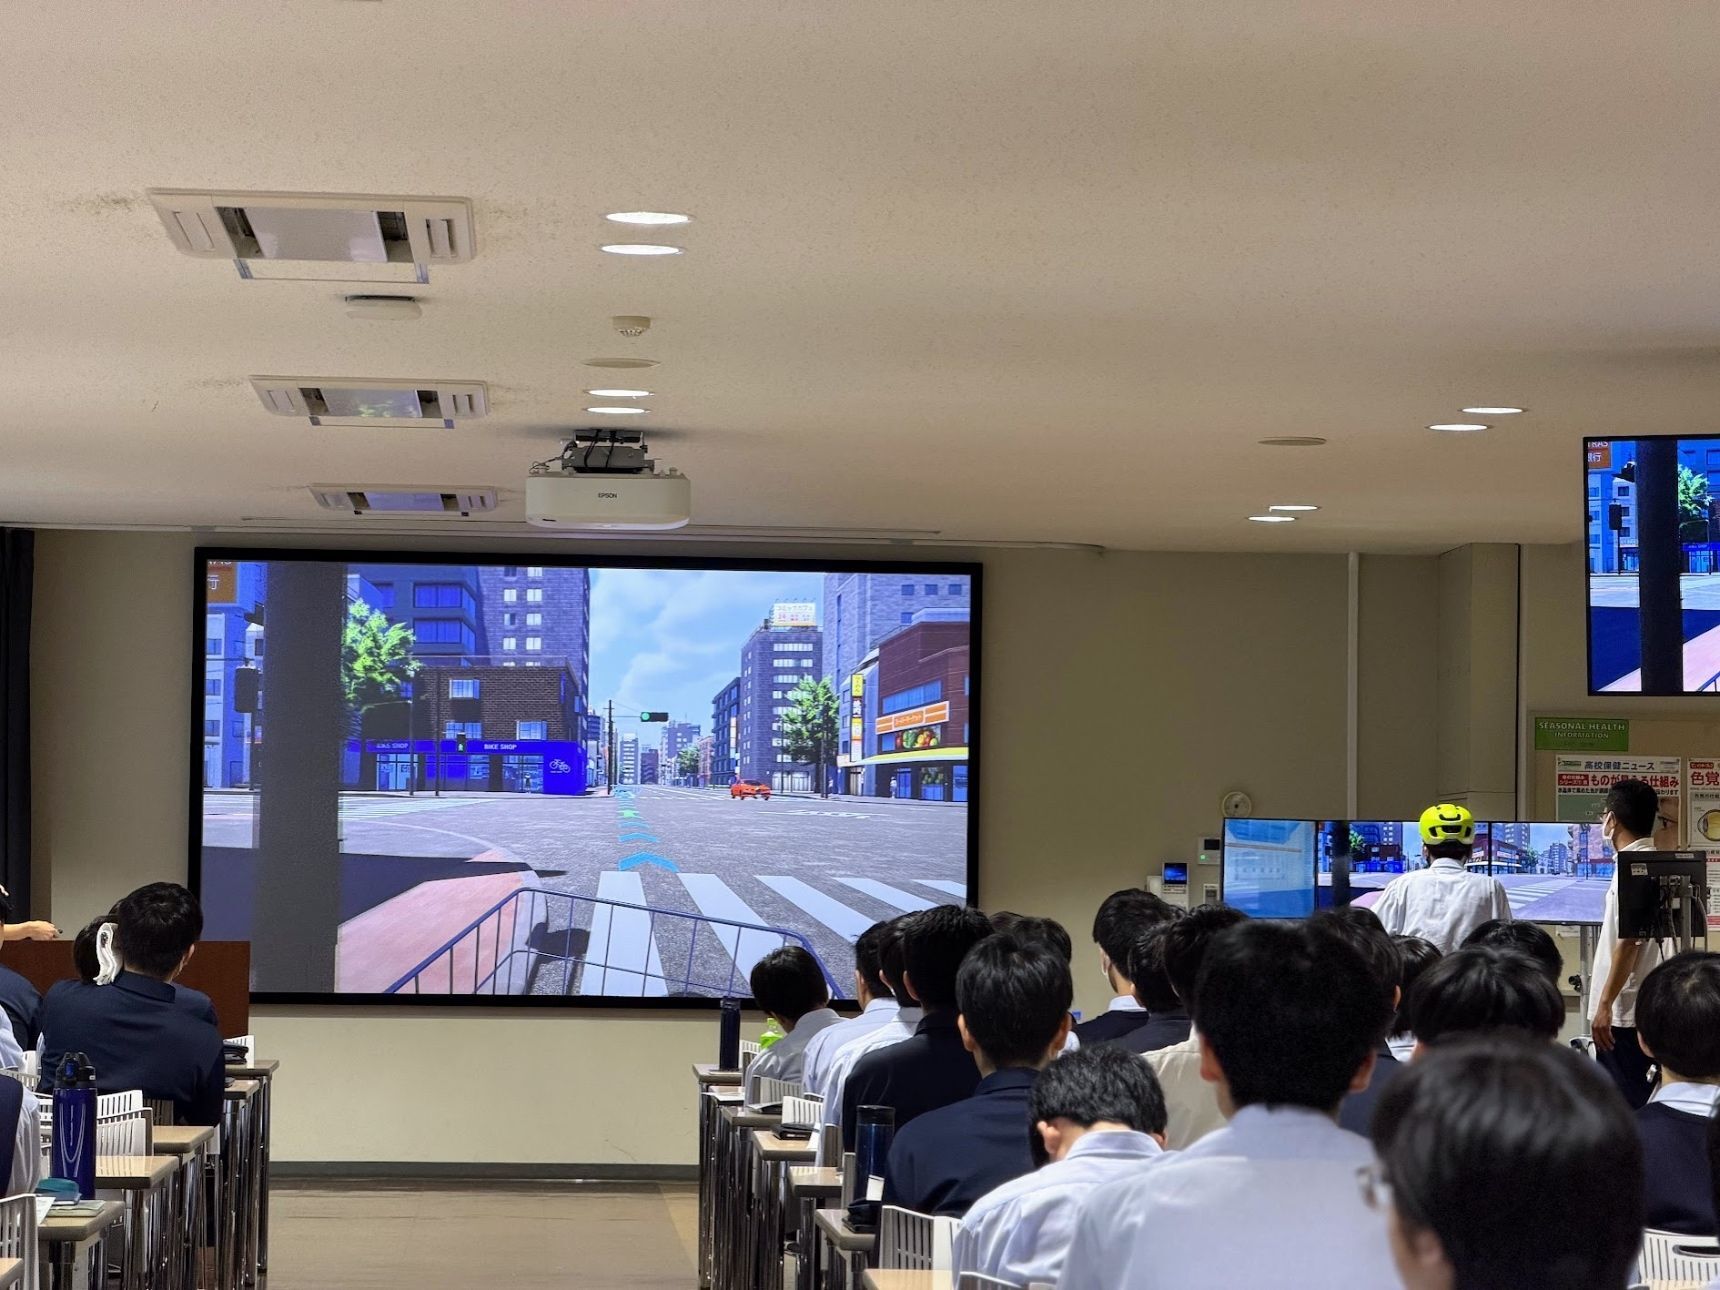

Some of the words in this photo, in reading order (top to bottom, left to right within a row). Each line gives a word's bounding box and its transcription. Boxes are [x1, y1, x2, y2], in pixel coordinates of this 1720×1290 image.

[1539, 721, 1587, 730] SEASONAL
[1589, 723, 1625, 731] HEALTH
[1584, 761, 1655, 771] 高校保健ニュース
